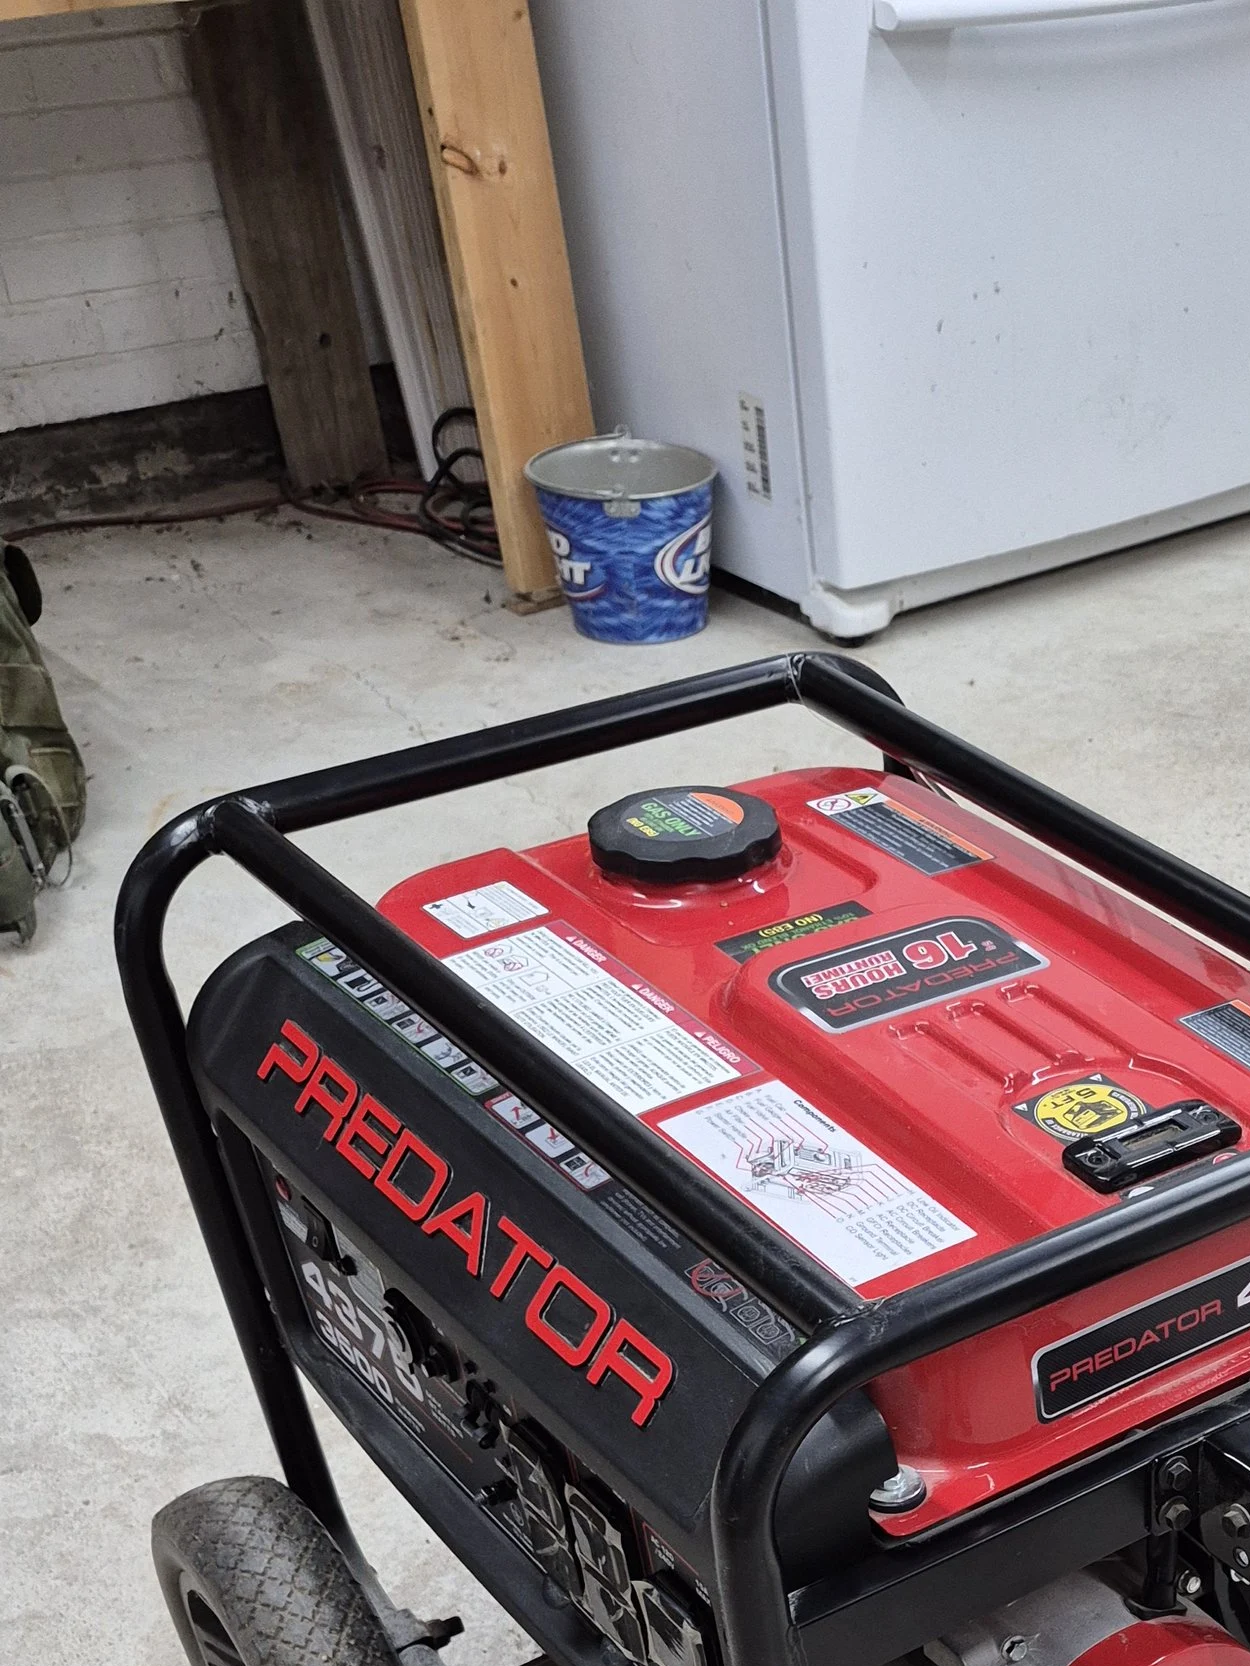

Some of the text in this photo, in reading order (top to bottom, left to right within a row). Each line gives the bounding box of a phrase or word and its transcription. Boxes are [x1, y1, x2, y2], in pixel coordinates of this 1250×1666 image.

[640, 802, 667, 819] GAS
[665, 818, 701, 837] ONLY
[758, 924, 794, 937] E85)
[795, 914, 823, 926] (NO
[573, 940, 607, 962] DANGER
[903, 931, 978, 970] 16
[801, 951, 897, 988] RUNTIME!
[813, 962, 907, 1000] HOURS
[826, 952, 1020, 1017] PREDATOR
[639, 987, 675, 1013] DANGER
[702, 1036, 740, 1063] PELIGRO
[1076, 1087, 1096, 1100] 5
[793, 1099, 836, 1132] Components
[256, 1018, 674, 1427] PREDATOR
[302, 1262, 424, 1401] 4375
[1050, 1299, 1222, 1391] PREDATOR
[316, 1310, 394, 1403] 3500
